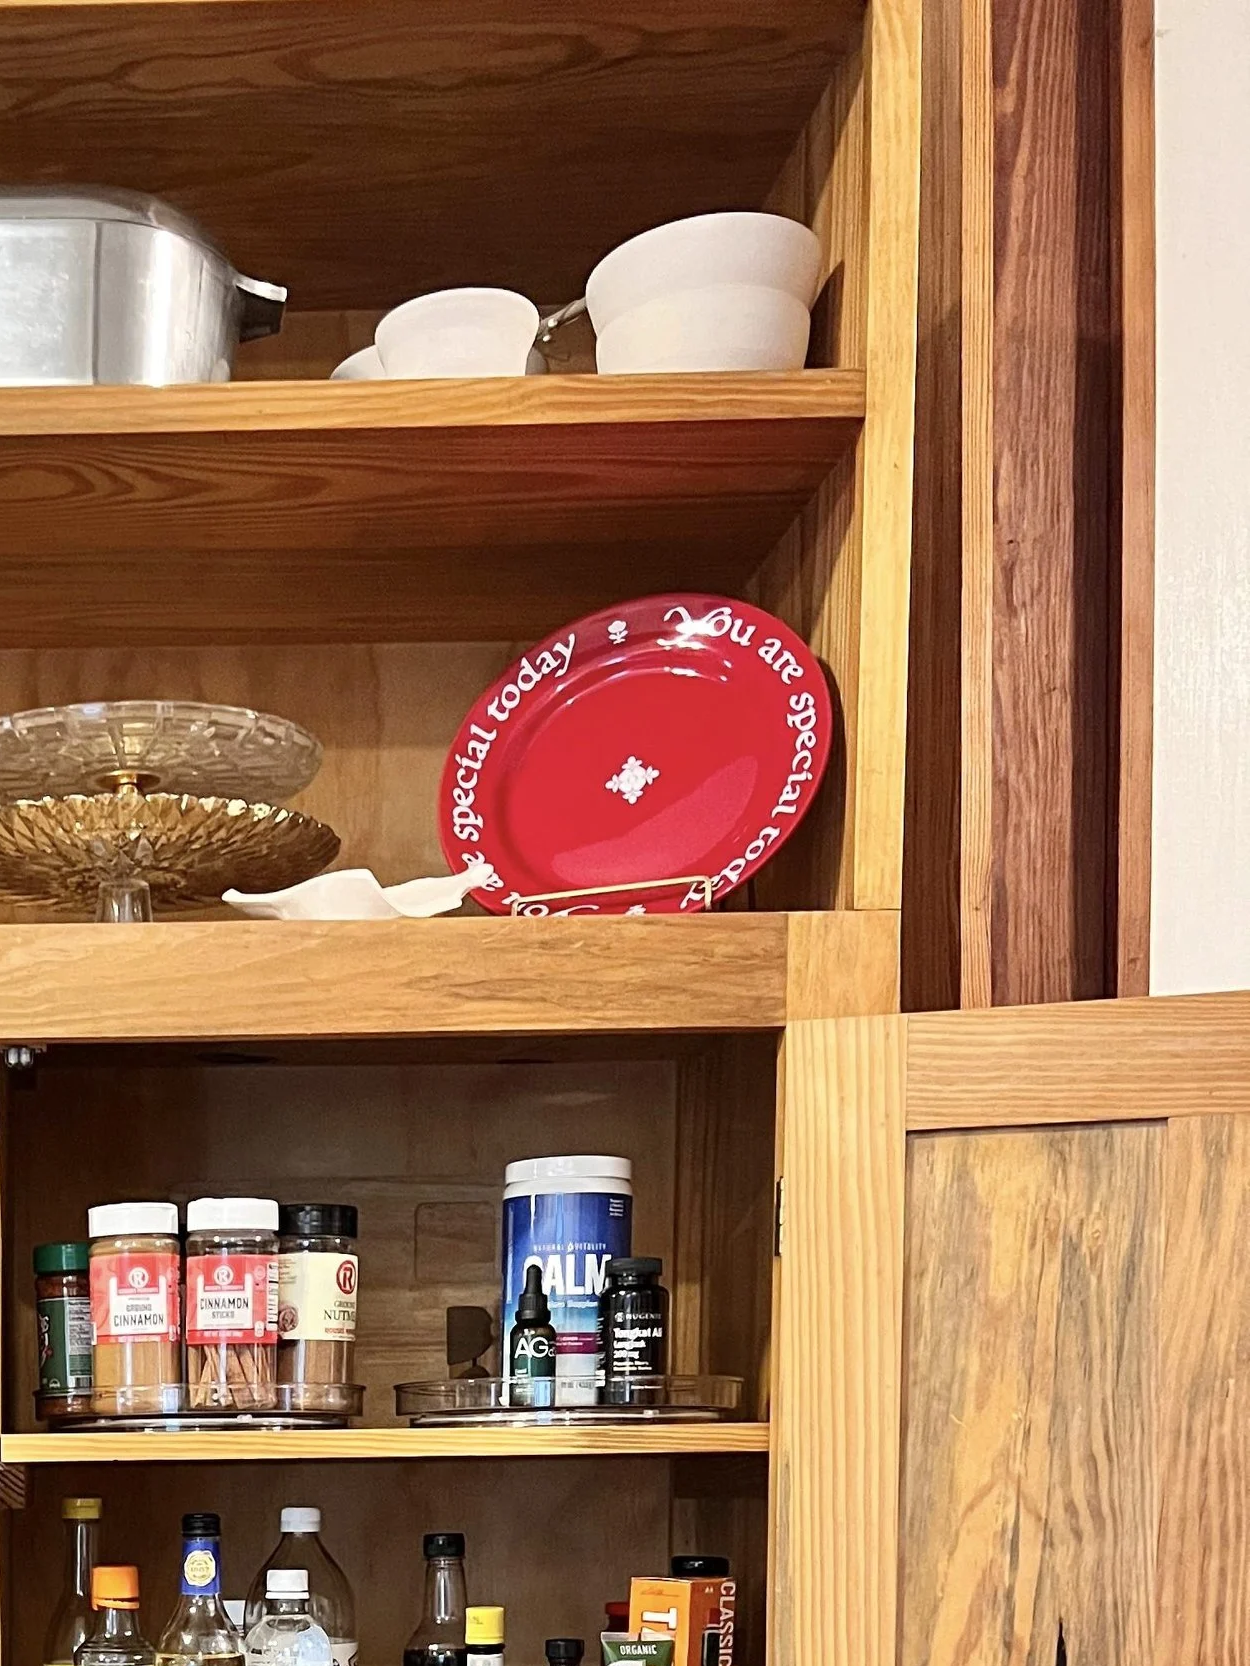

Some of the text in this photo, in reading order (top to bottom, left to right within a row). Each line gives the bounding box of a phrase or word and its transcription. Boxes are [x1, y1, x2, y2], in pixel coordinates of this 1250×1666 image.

[757, 636, 805, 685] are
[451, 632, 577, 843] special today
[772, 690, 818, 819] special
[679, 826, 781, 910] today
[574, 1243, 606, 1251] VITALITY
[126, 1304, 153, 1312] GROUND
[200, 1297, 249, 1311] CINNAMON
[113, 1314, 164, 1327] CINNAMON
[211, 1311, 235, 1320] STICKS
[620, 1644, 657, 1656] ORGANIC
